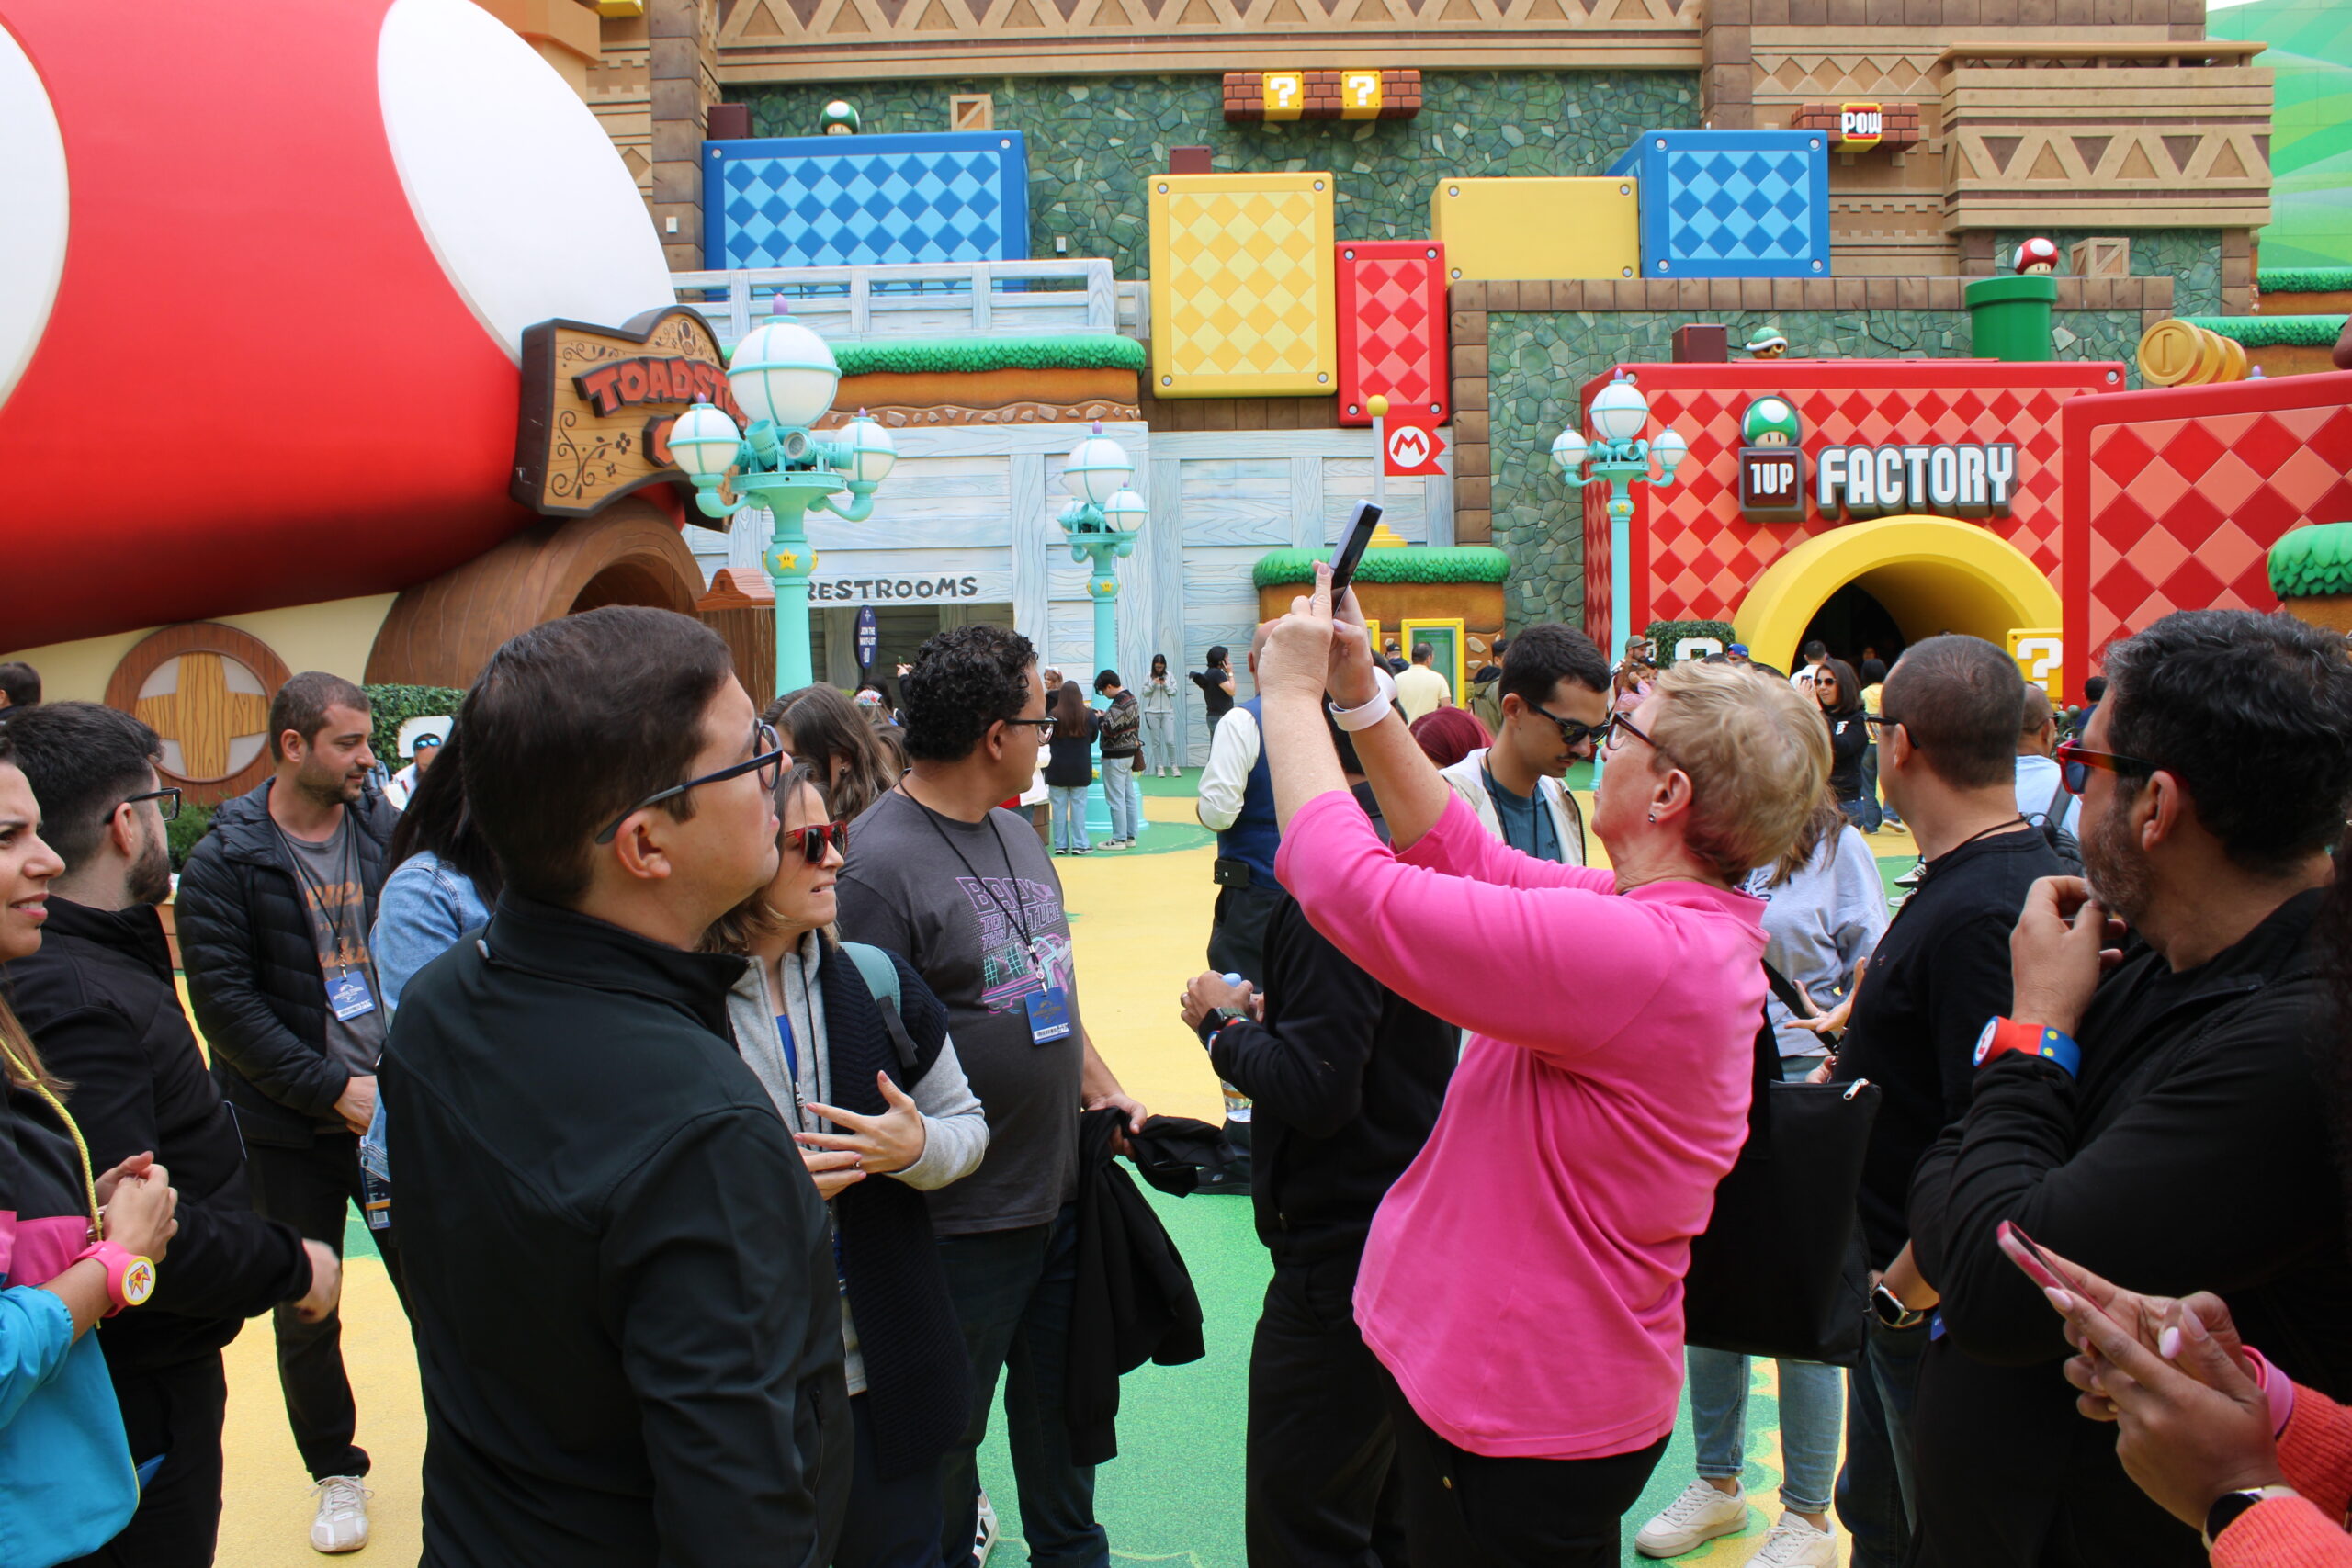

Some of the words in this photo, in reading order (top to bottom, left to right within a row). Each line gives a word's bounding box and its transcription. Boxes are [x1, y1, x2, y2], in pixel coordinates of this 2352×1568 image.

[1841, 112, 1882, 134] POW
[1392, 433, 1426, 457] M
[1749, 463, 1794, 494] 1UP
[1820, 446, 2013, 504] FACTORY
[956, 876, 1046, 914] BACK
[980, 913, 1001, 933] TO
[982, 929, 1004, 952] THE
[1002, 902, 1060, 942] FUTURE
